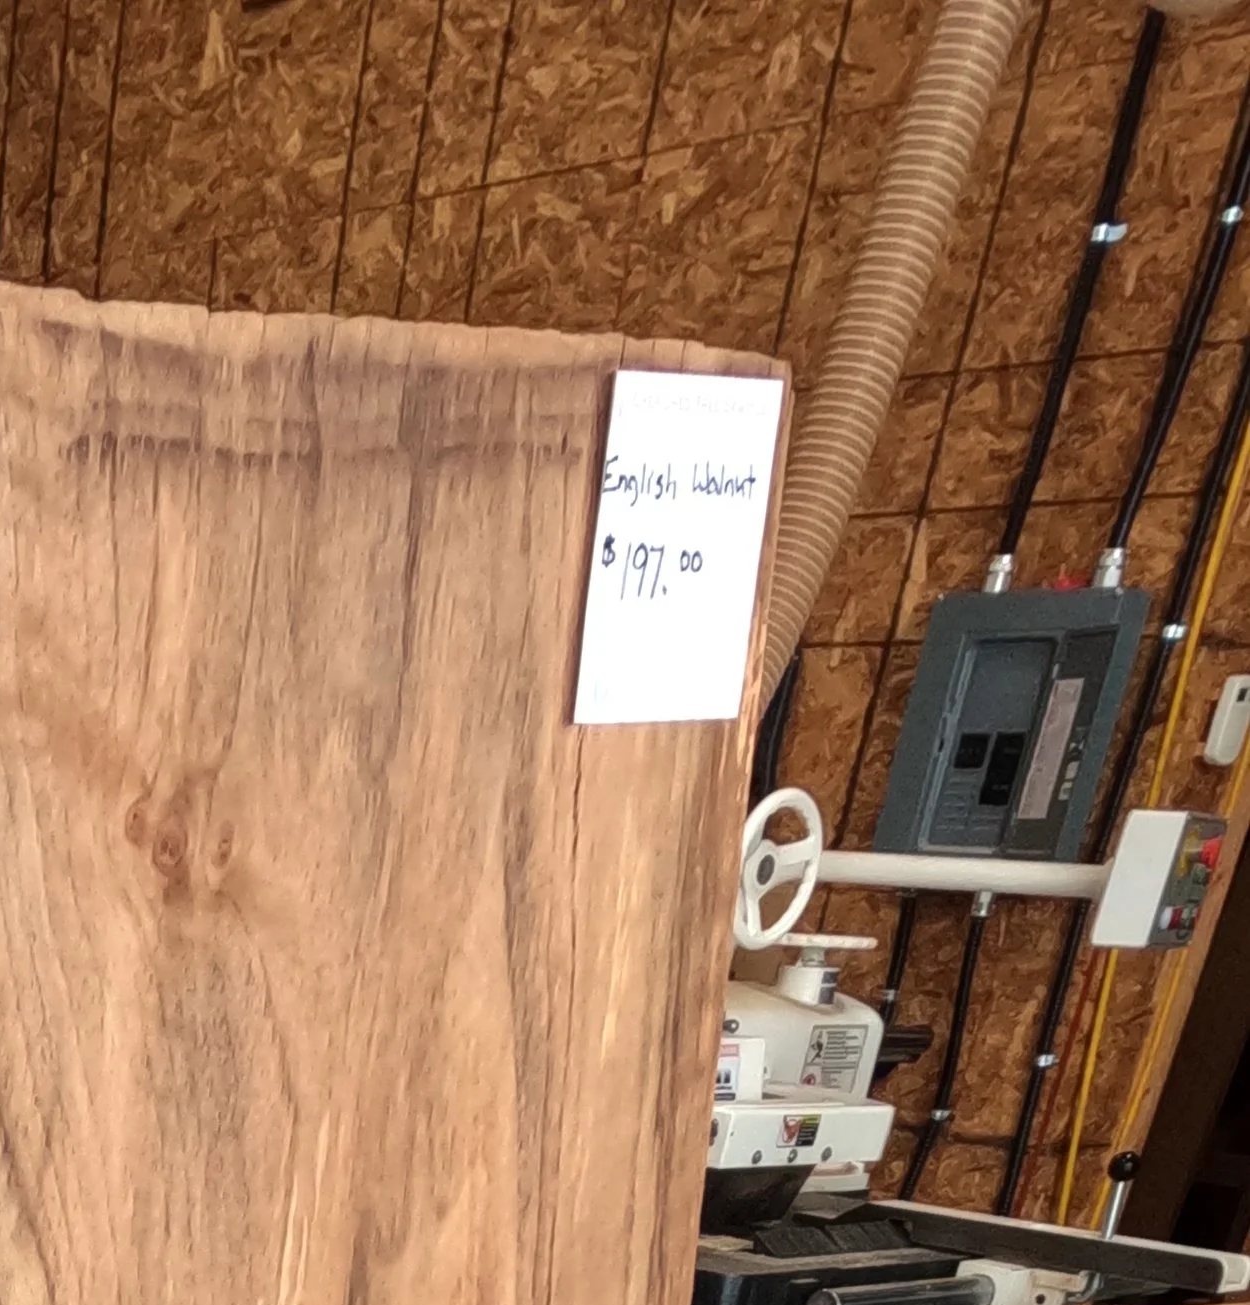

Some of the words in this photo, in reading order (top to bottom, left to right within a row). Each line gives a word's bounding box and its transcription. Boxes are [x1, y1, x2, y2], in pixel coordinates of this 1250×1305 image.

[601, 454, 677, 508] English
[691, 459, 757, 501] Walnut
[600, 533, 704, 601] $197.00
